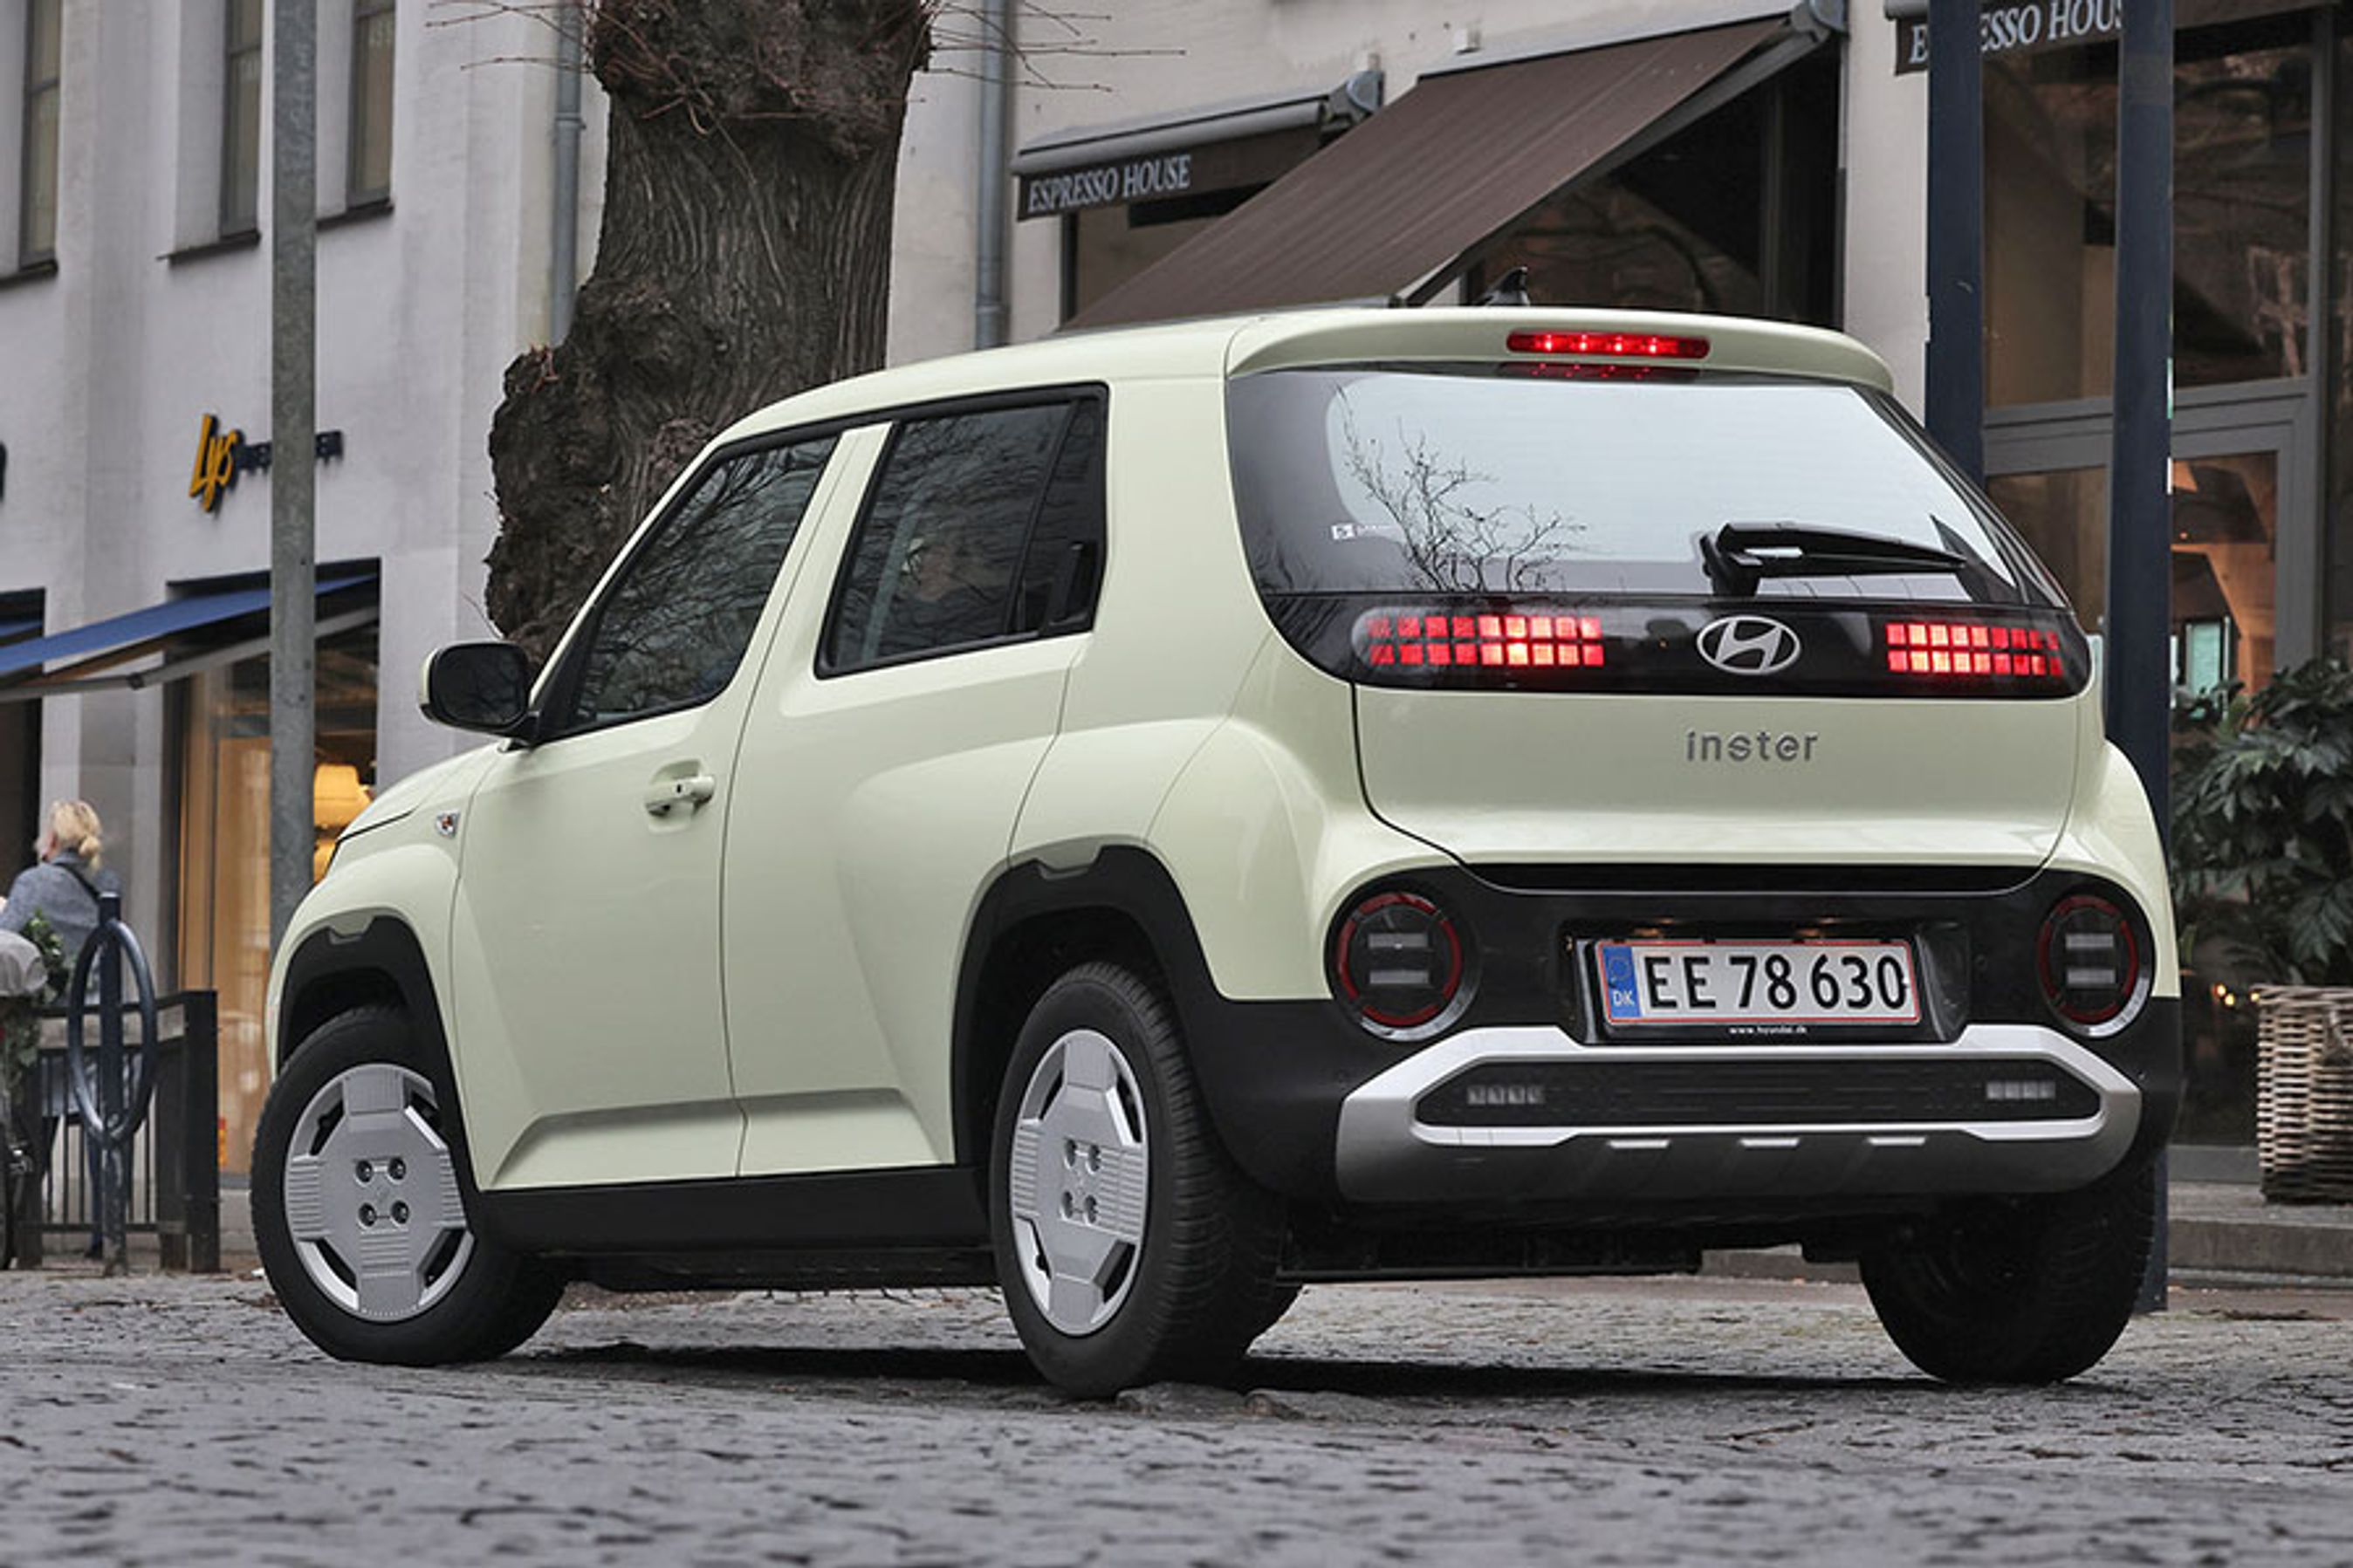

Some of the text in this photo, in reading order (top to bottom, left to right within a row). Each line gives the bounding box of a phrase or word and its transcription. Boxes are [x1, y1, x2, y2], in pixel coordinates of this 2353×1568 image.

[1909, 0, 2122, 64] ESSO HOU
[1028, 154, 1191, 213] ESPRESSO HOUSE
[1686, 730, 1819, 762] inster
[1613, 989, 1635, 1006] DK
[1643, 954, 1907, 1010] EE 78 630
